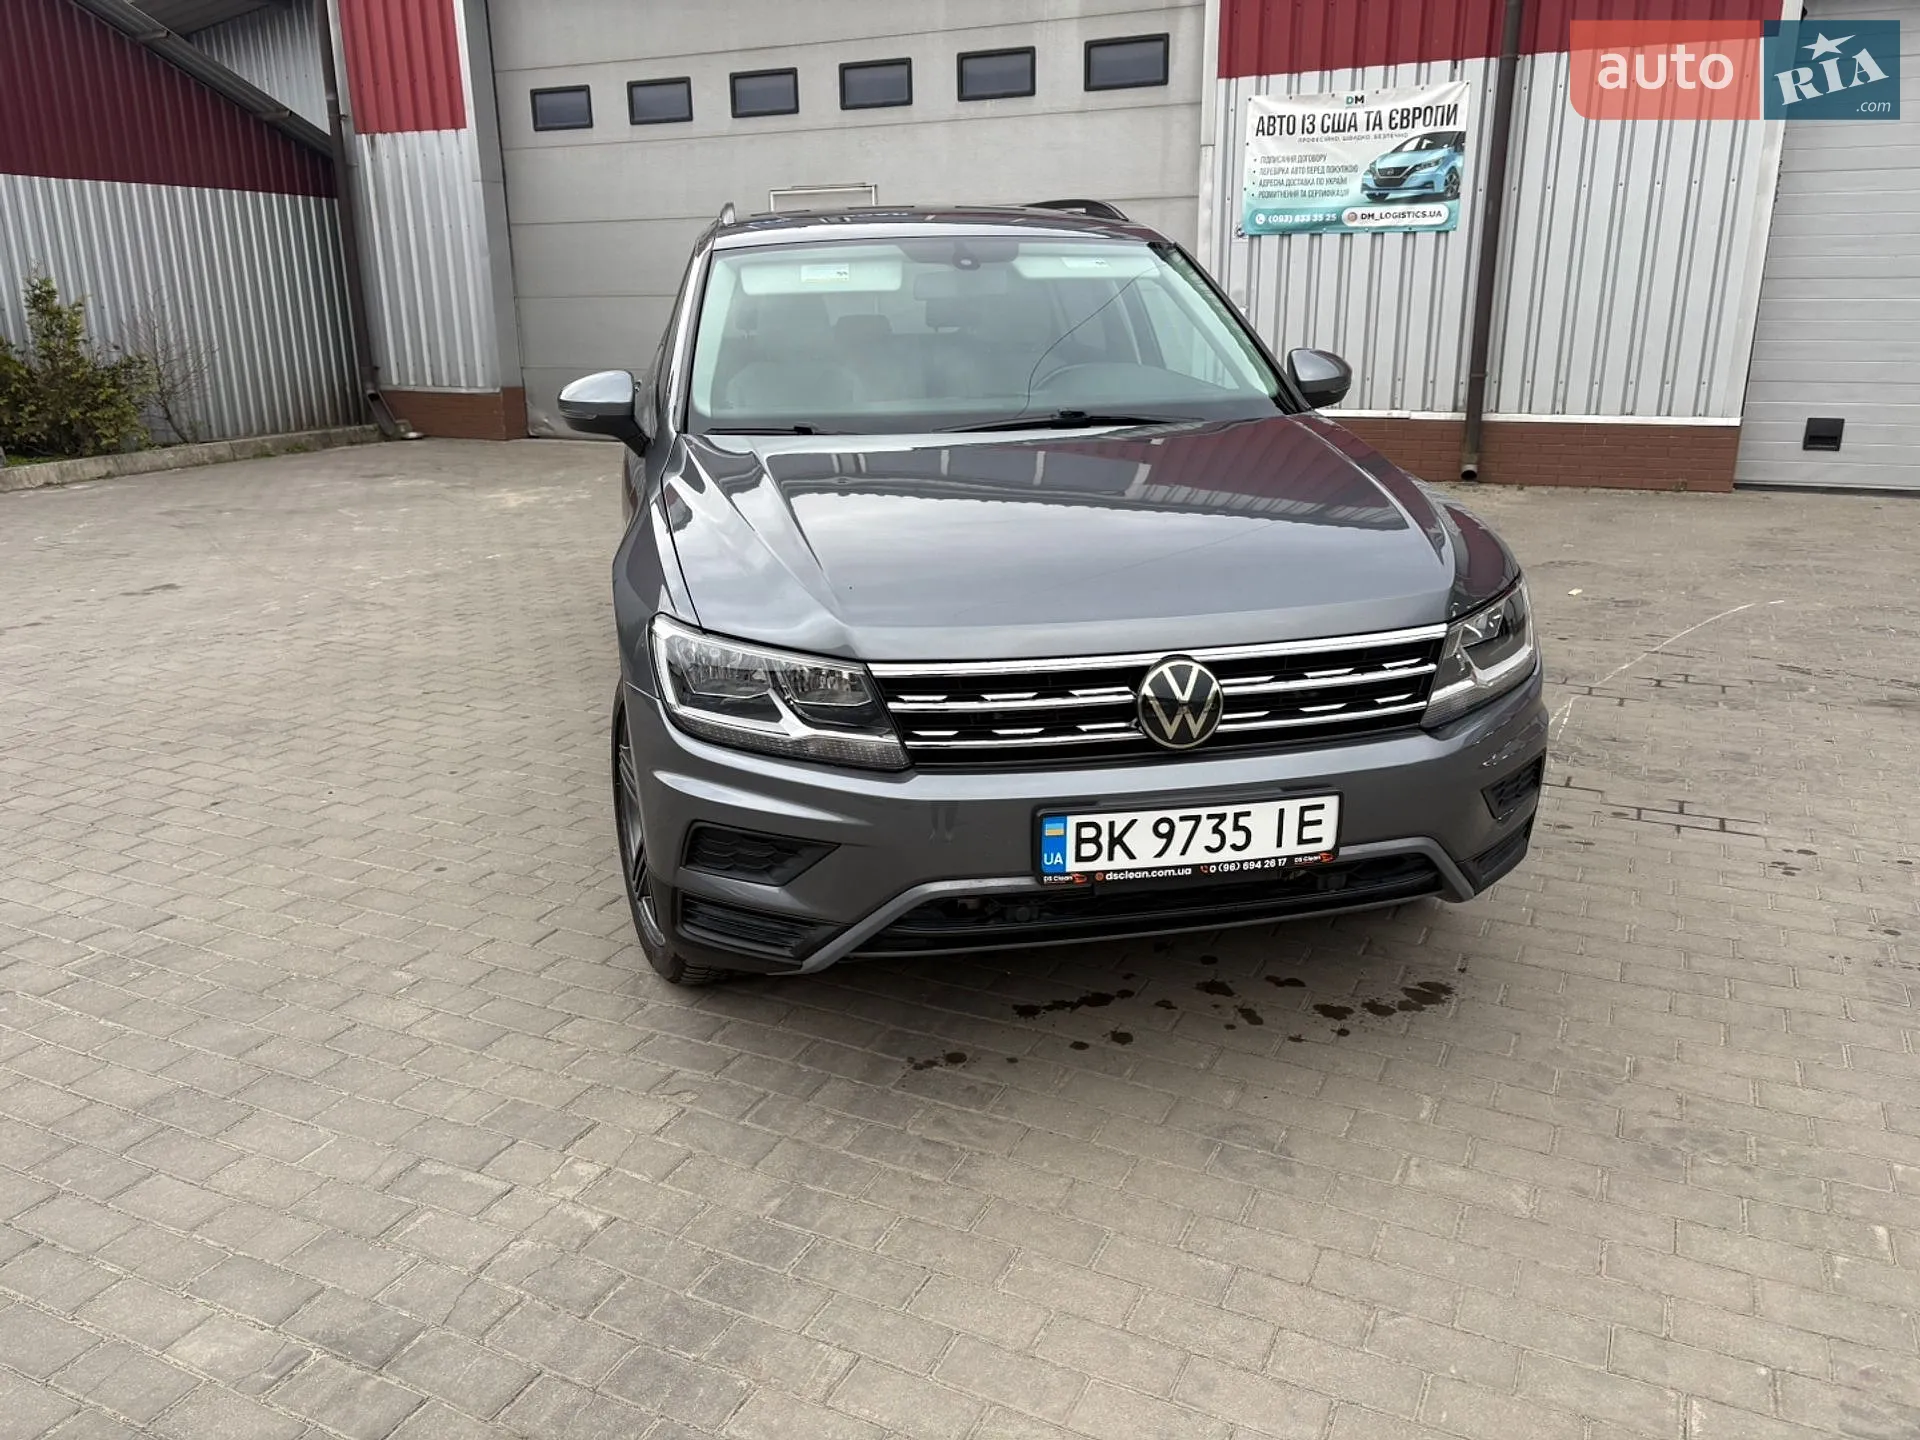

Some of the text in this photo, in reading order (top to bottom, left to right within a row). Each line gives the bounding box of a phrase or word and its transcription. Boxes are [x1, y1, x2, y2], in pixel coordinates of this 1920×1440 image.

[1345, 95, 1365, 105] DM
[1255, 103, 1458, 137] АВТО ІЗ США ТА ЄВРОПИ
[1290, 166, 1306, 175] АВТО
[1360, 209, 1443, 221] DM_LOGISTICS.UA
[1074, 818, 1139, 863] BK
[1152, 810, 1252, 859] 9735
[1043, 852, 1064, 865] UA
[1242, 860, 1261, 870] 694
[1277, 857, 1288, 867] 17
[1105, 867, 1192, 881] dsclean.com.ua
